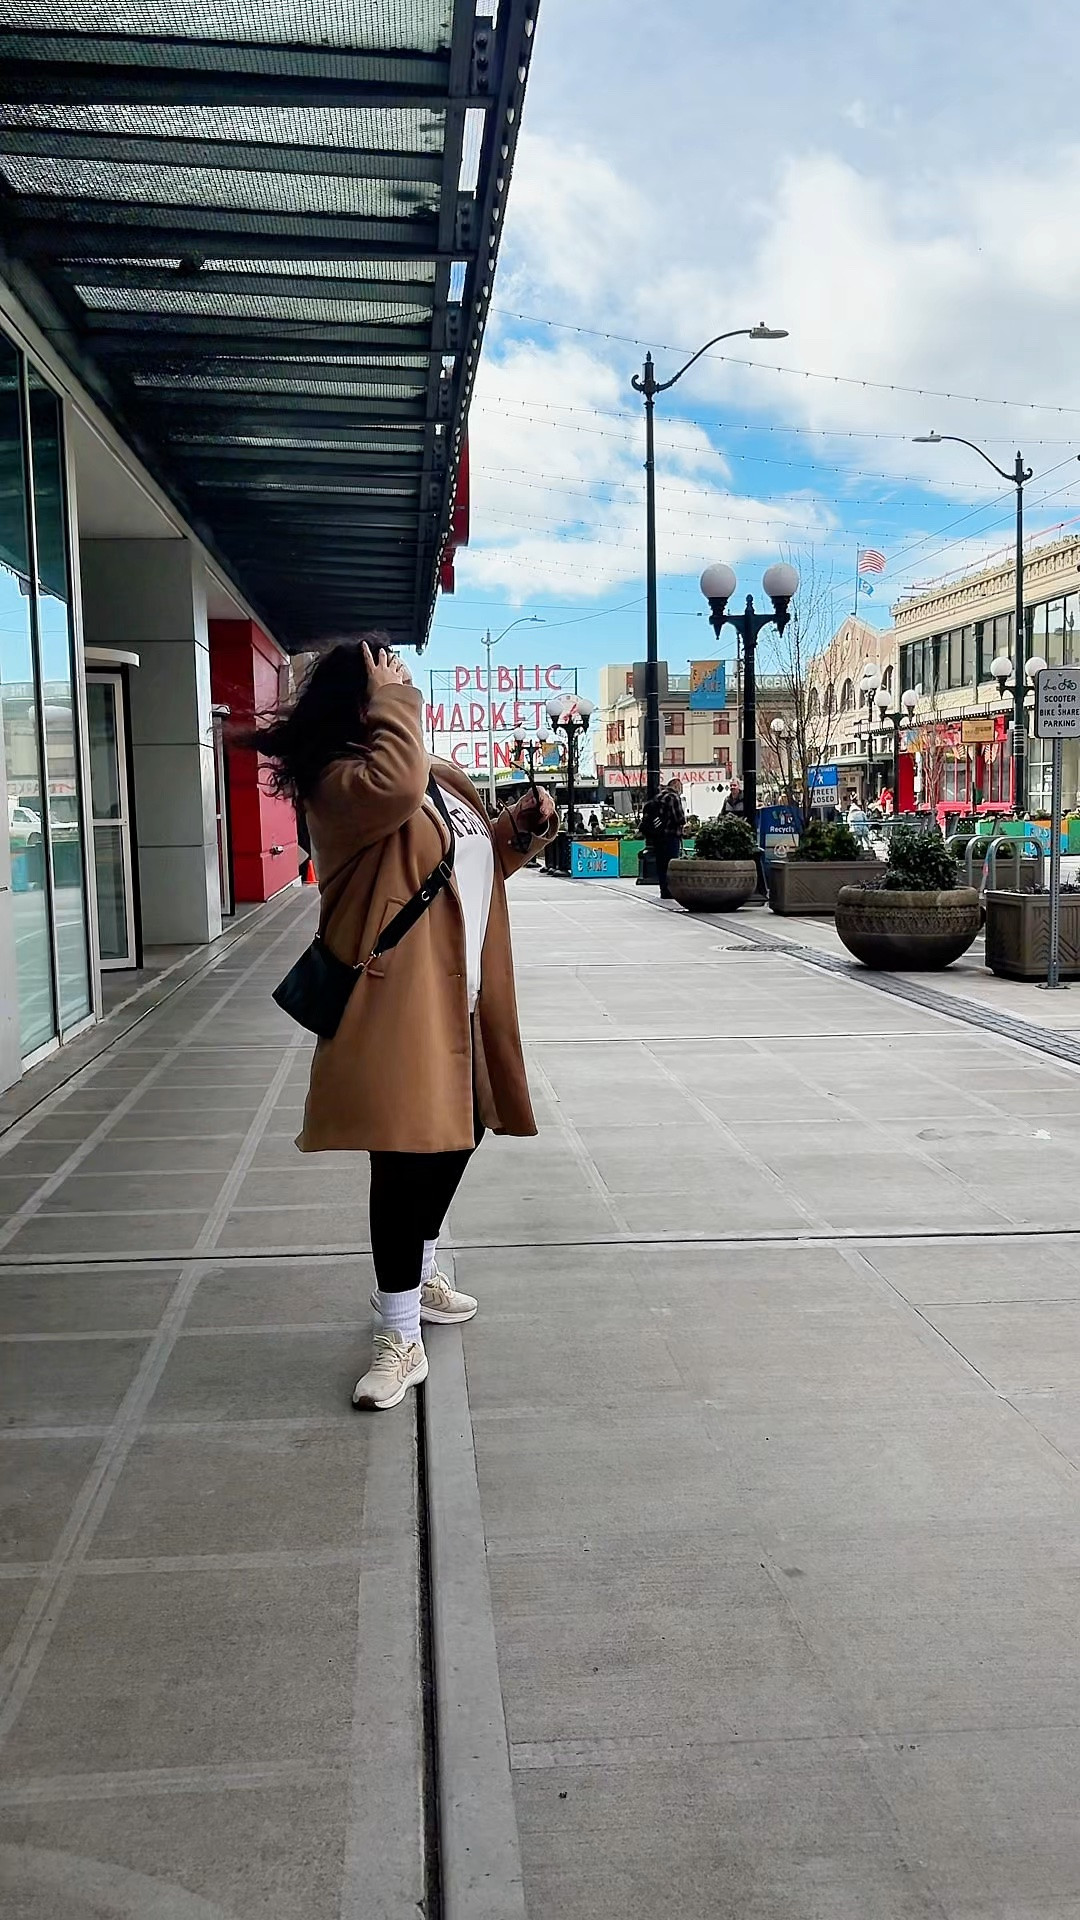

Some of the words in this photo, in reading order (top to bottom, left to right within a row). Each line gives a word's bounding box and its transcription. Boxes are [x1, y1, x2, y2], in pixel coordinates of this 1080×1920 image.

[455, 664, 562, 692] PUBLIC
[425, 701, 546, 732] MARKET
[672, 770, 722, 783] MARKET
